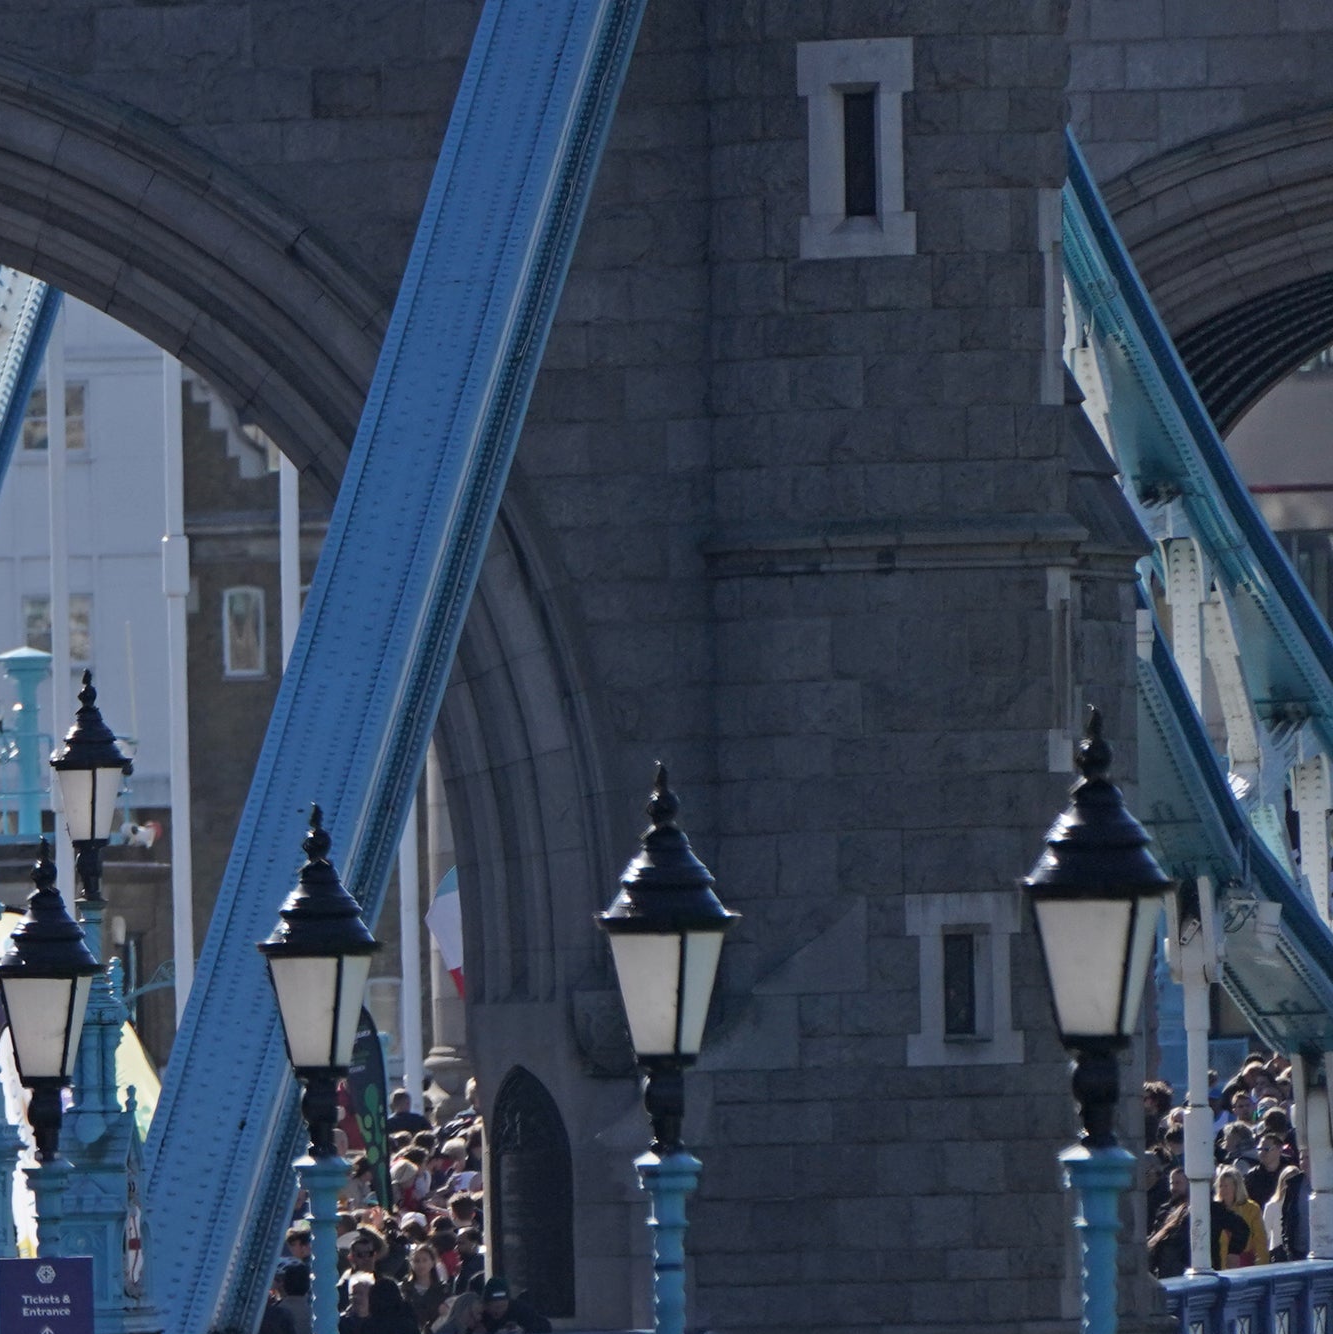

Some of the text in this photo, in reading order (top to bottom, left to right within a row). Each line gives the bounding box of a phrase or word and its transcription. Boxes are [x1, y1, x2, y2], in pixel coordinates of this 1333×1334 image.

[22, 1295, 71, 1305] Tickets &
[23, 1308, 71, 1317] Entrance
